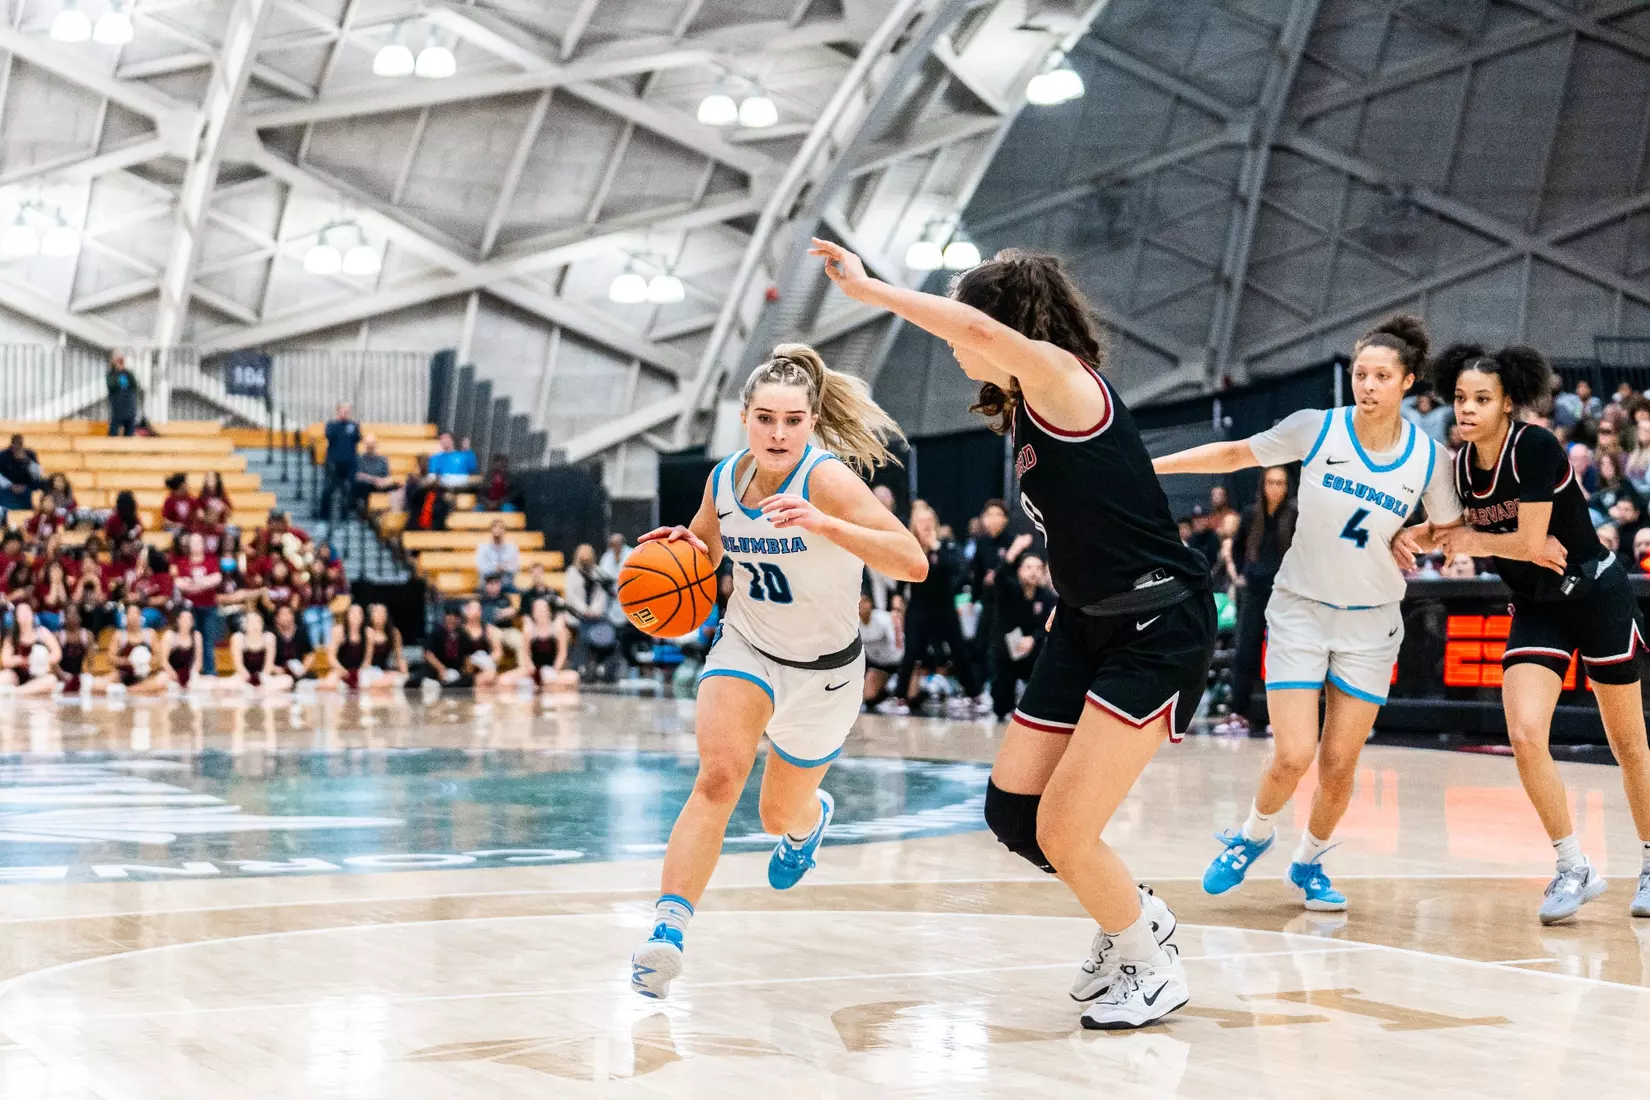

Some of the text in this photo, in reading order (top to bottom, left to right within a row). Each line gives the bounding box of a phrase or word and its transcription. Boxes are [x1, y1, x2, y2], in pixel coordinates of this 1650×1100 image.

[1322, 473, 1408, 519] COLUMBIA
[1470, 498, 1520, 526] ARVAR
[720, 535, 807, 554] OLUMBIA
[1339, 506, 1371, 549] 4
[738, 561, 793, 605] 10
